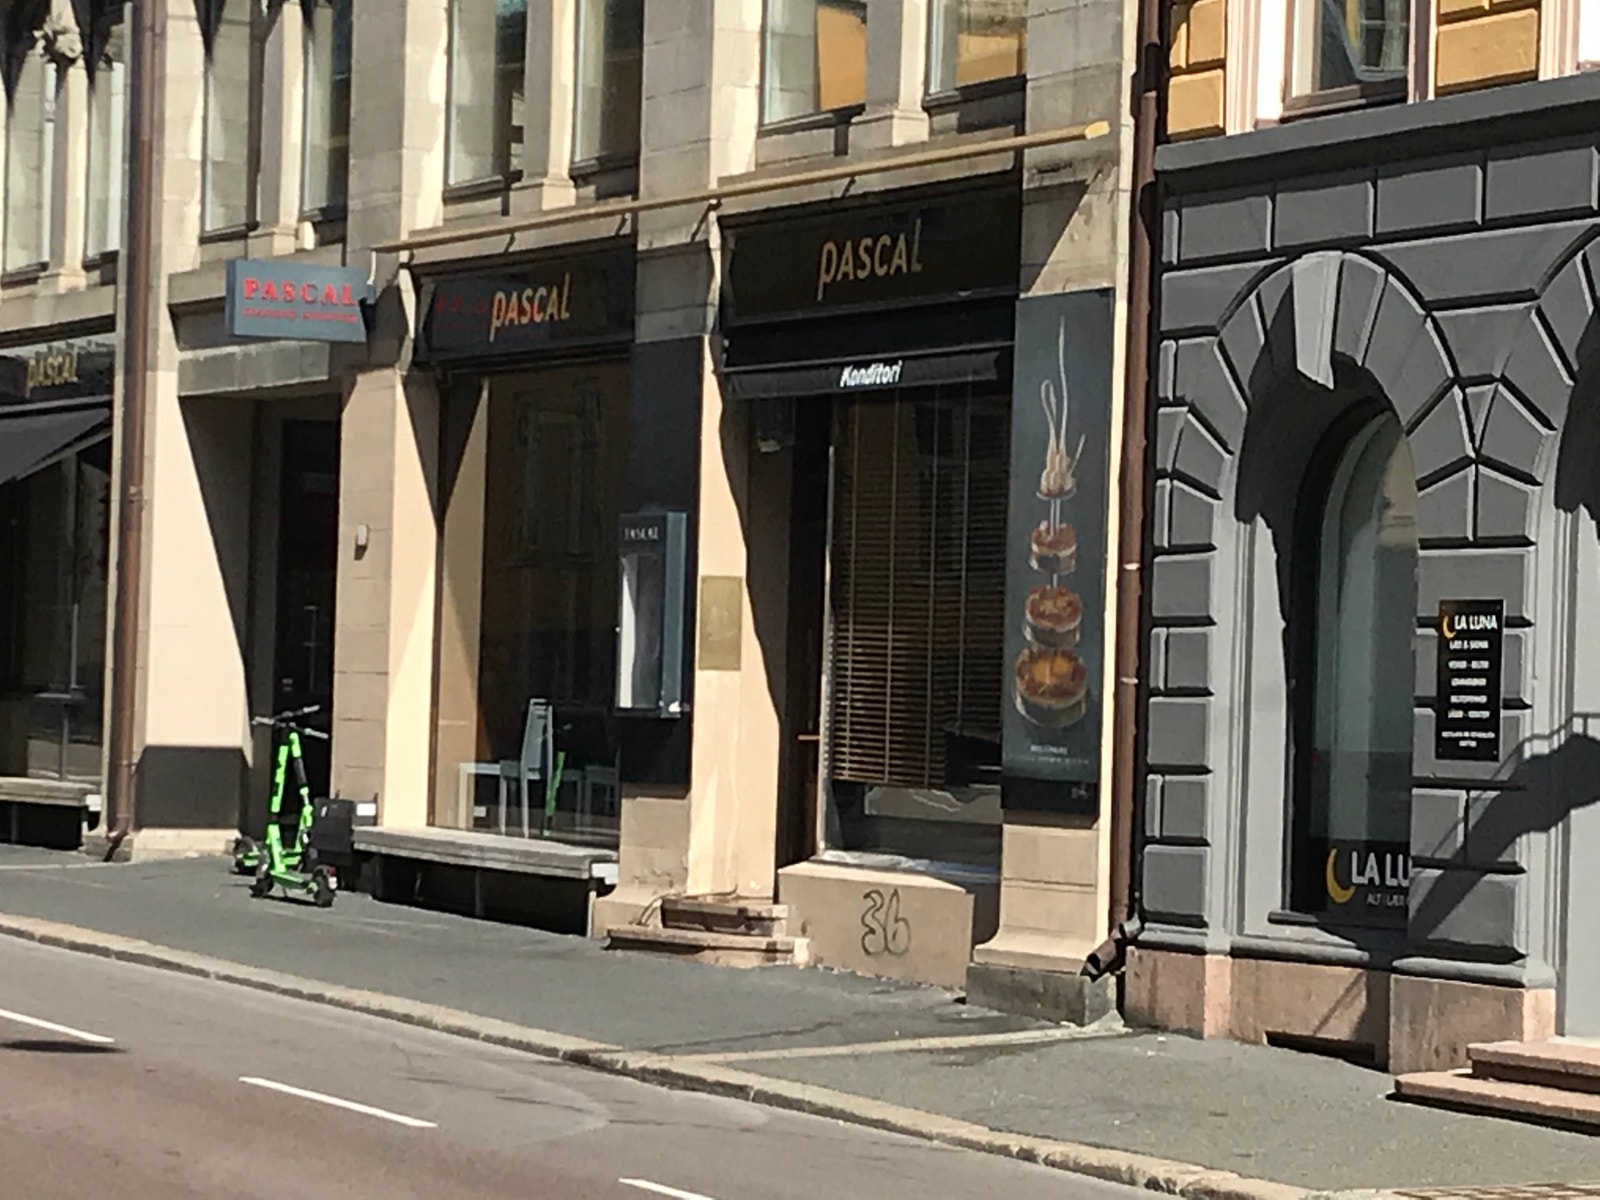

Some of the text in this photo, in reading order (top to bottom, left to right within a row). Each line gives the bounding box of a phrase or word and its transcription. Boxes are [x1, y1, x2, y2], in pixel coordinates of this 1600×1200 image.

[817, 217, 924, 302] PASCAL
[243, 276, 359, 307] PASCAL
[488, 271, 571, 344] PASCAL
[839, 359, 903, 388] Konditori
[1454, 614, 1498, 630] LA LUNA
[1352, 851, 1380, 886] LA
